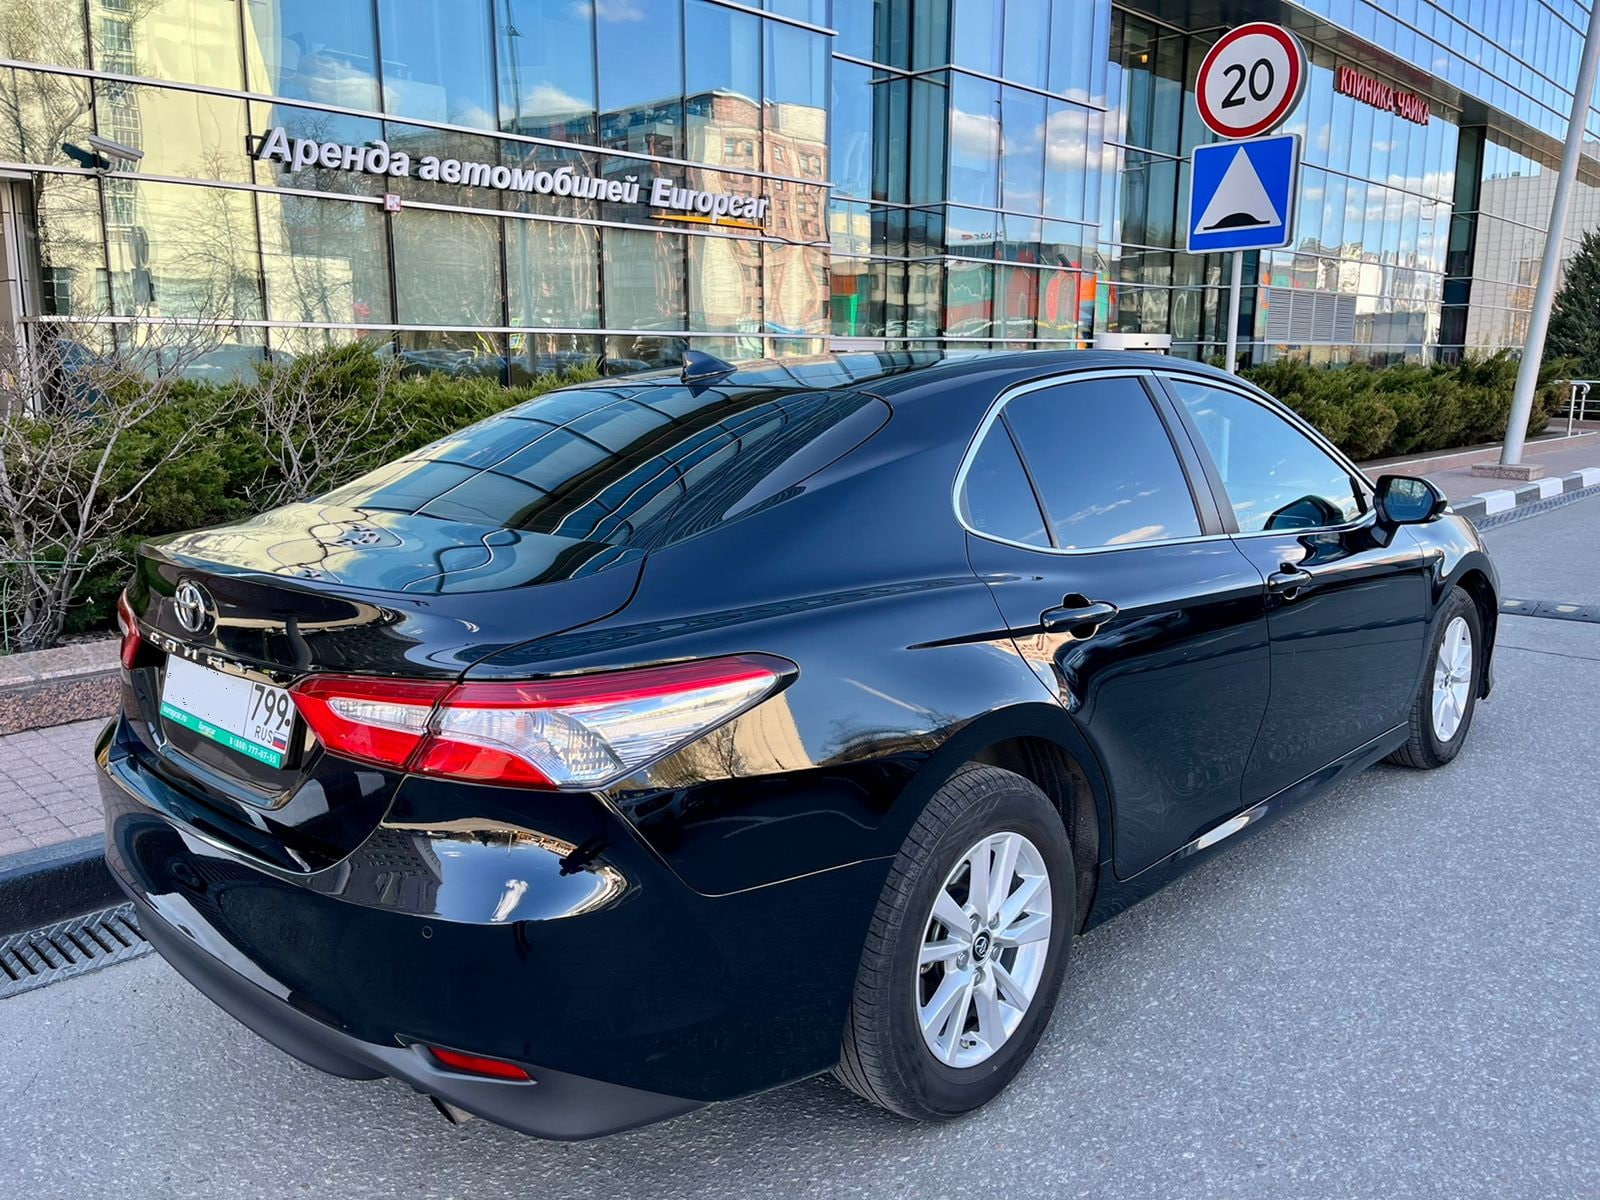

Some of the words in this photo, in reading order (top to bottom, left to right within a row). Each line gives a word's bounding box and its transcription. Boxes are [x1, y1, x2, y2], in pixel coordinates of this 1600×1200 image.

[1221, 58, 1274, 109] 20
[1340, 65, 1395, 111] КЛИНИКА
[1397, 91, 1430, 124] ЧАЙКА
[260, 126, 410, 177] Аренда
[418, 156, 640, 204] автомобилей
[650, 177, 769, 224] Europcar
[251, 685, 289, 731] 799
[255, 725, 273, 744] RUS
